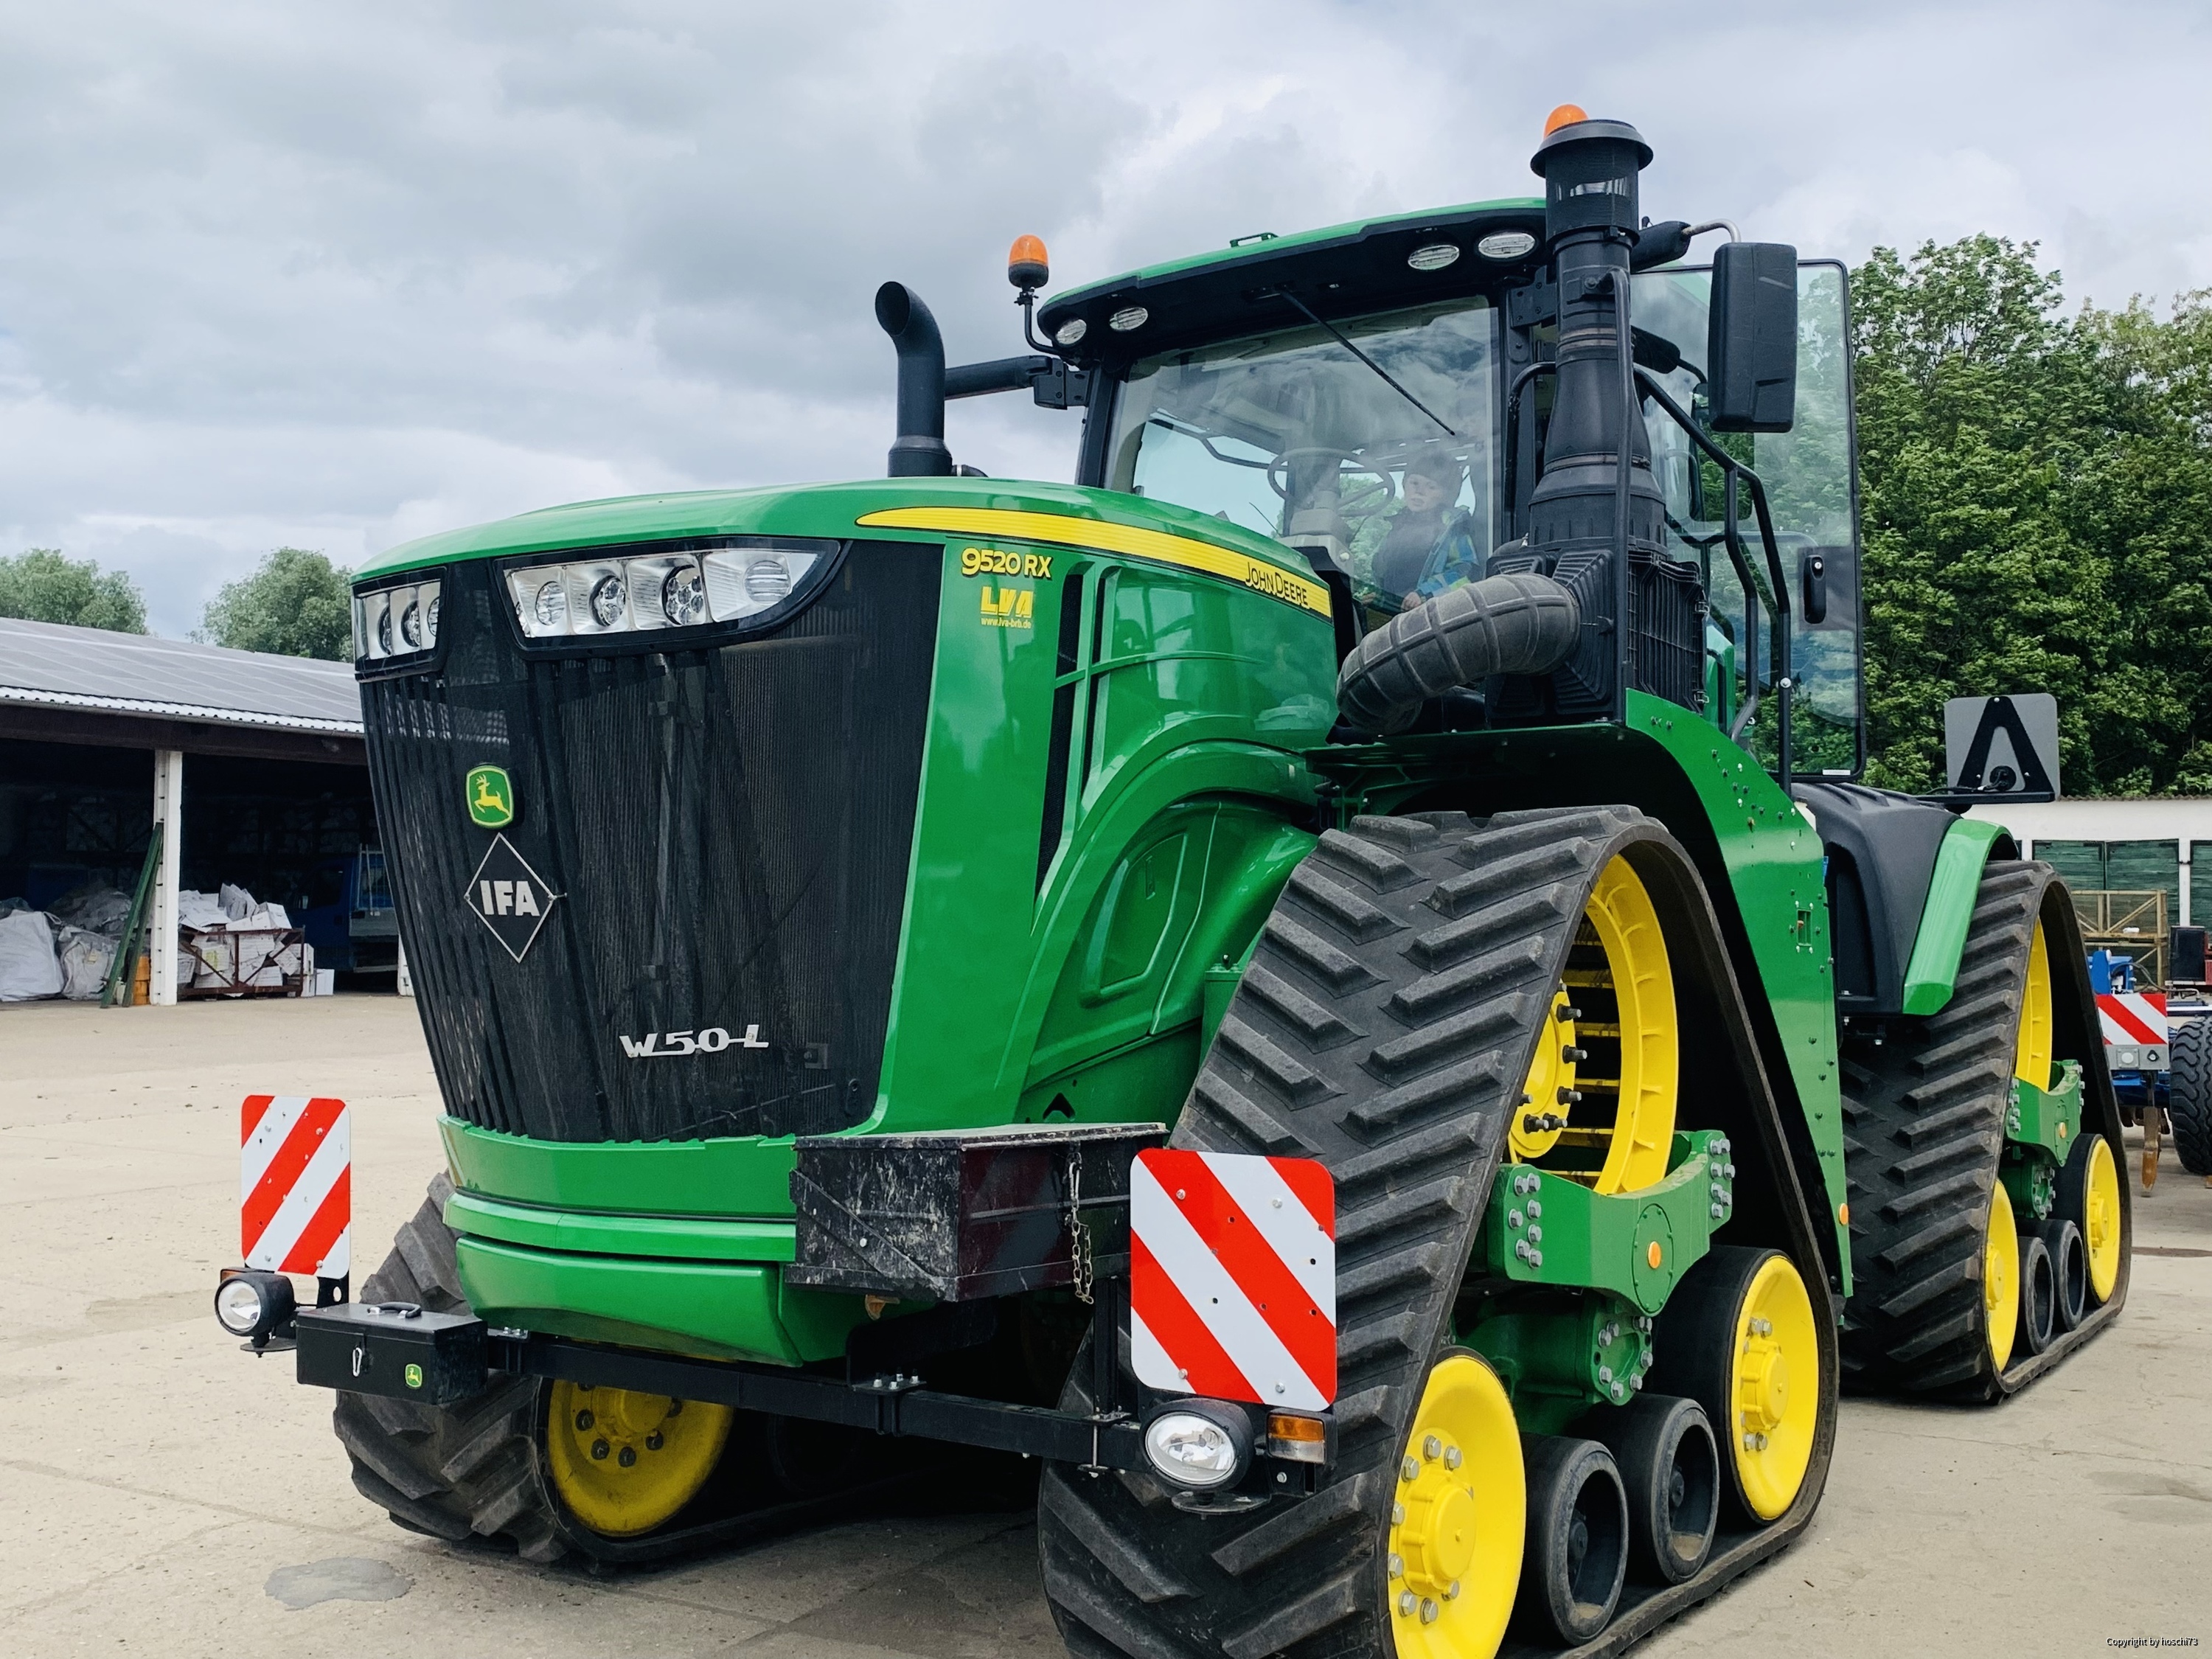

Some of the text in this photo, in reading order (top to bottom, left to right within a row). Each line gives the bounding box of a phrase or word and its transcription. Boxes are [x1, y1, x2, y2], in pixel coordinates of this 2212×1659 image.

[961, 547, 1053, 580] 9520 RX
[1245, 562, 1310, 609] JOHN DEERE
[981, 618, 1032, 629] www.lva-brb.de
[479, 880, 540, 917] IFA
